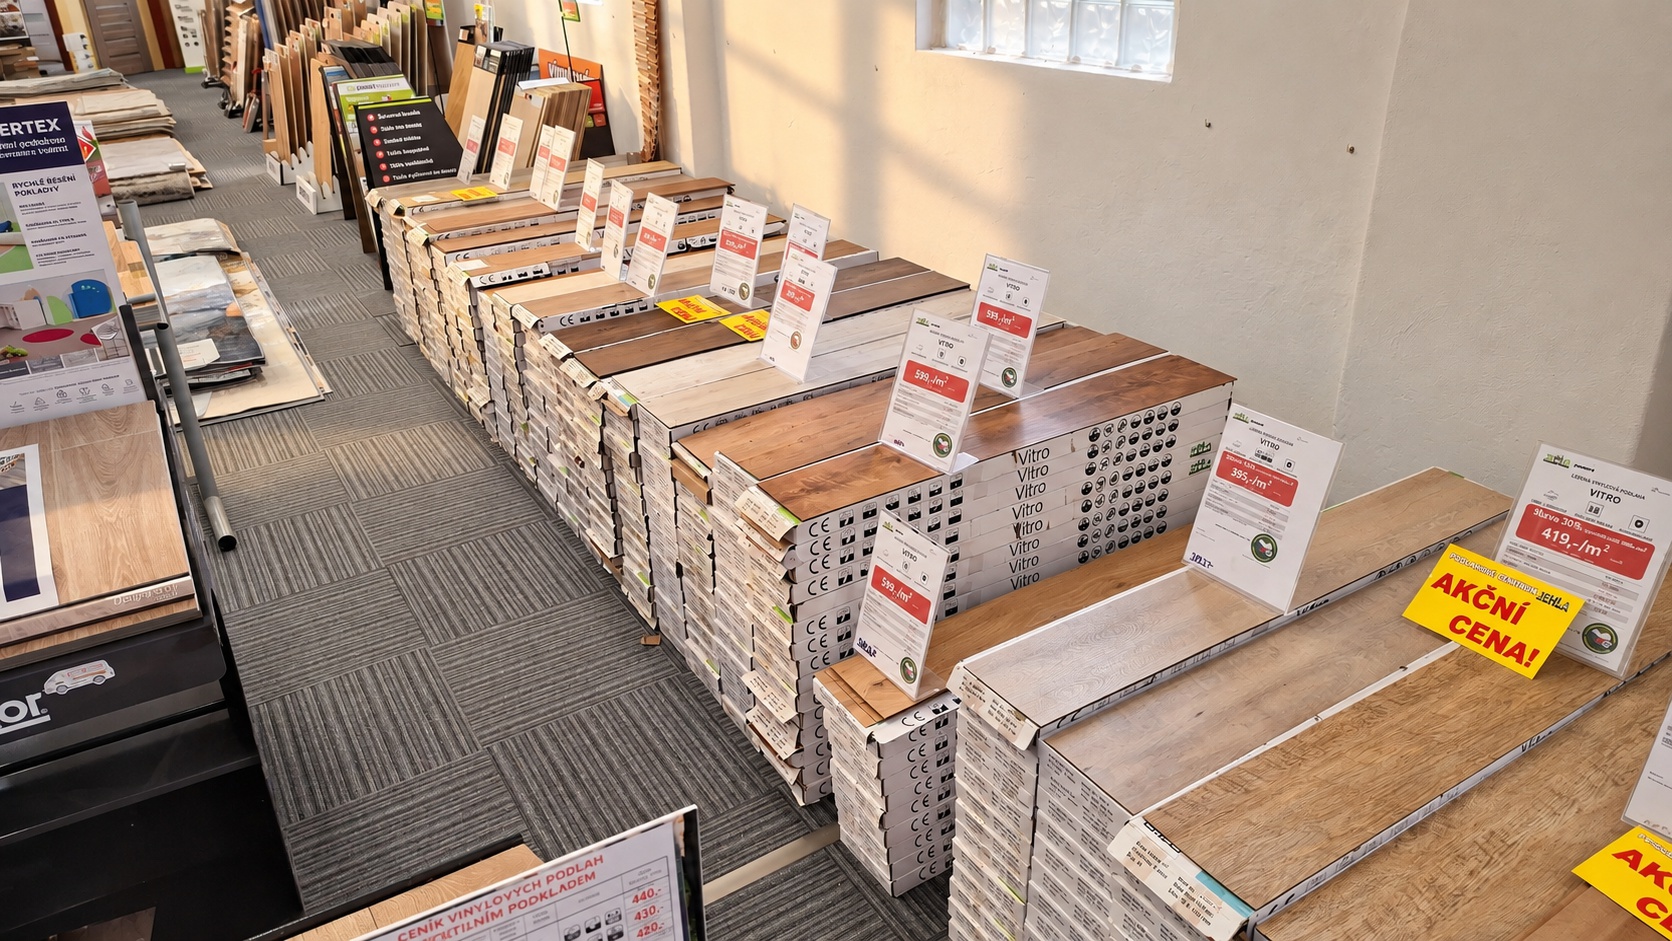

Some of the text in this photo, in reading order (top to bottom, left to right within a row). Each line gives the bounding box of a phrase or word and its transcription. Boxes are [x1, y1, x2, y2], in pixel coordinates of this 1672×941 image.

[1018, 447, 1050, 466] Vitro
[1589, 487, 1622, 505] VITRO
[1012, 501, 1043, 520] Vitro
[1009, 538, 1040, 557] Vitro
[1009, 555, 1039, 574] Vitro
[1010, 572, 1040, 591] Vitro
[1431, 572, 1532, 626] AKČNÍ
[1448, 614, 1541, 668] CENA!
[546, 855, 604, 885] PODLAH
[1611, 849, 1672, 895] AK
[508, 871, 597, 914] PODKLADEM
